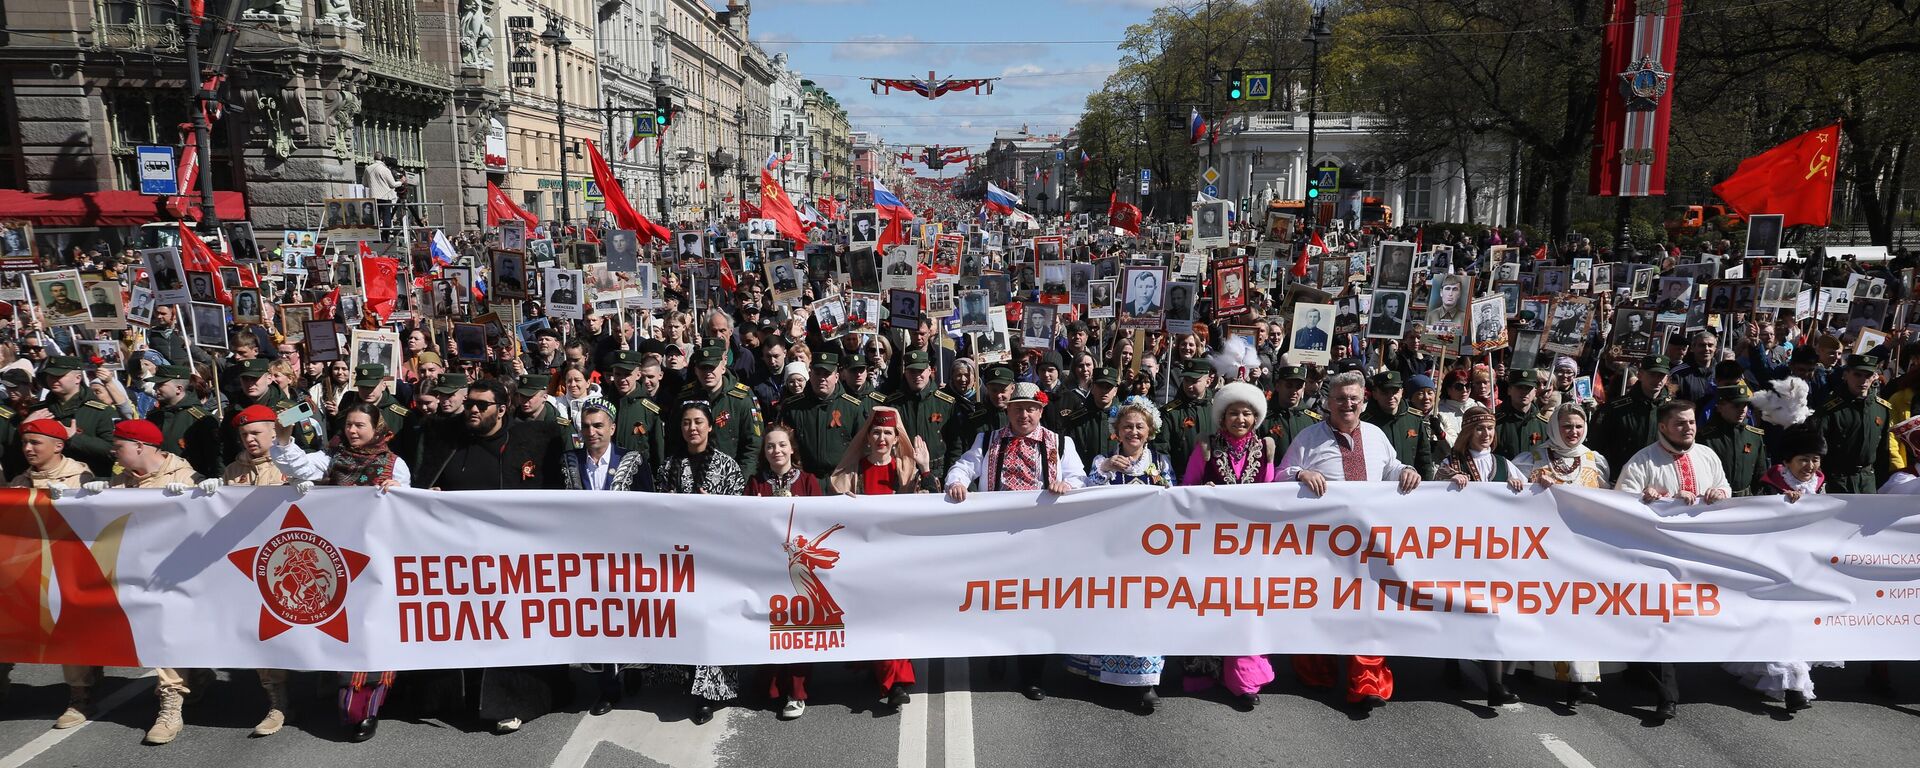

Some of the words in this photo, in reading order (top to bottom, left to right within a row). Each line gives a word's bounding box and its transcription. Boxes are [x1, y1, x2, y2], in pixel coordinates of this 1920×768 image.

[271, 532, 316, 548] ВЕЛИКОЙ
[1141, 523, 1200, 556] ОТ
[1213, 523, 1550, 566] БЛАГОДАРНЫХ
[260, 546, 273, 564] ЛЕТ
[318, 539, 345, 578] ПОБЕДЫ
[258, 565, 267, 577] 80
[394, 545, 695, 596] БЕССМЕРТНЫЙ
[769, 594, 810, 626] 80
[959, 576, 1318, 617] ЛЕНИНГРАДЦЕВ
[1332, 577, 1362, 610] И
[1377, 579, 1721, 623] ПЕТЕРБУРЖЦЕВ
[281, 610, 297, 621] 1941
[310, 610, 328, 621] 1945
[399, 600, 509, 643] ПОЛК
[521, 598, 677, 639] РОССИИ
[1825, 612, 1909, 626] ЛАТВИЙСКАЯ
[769, 631, 845, 652] ПОБЕДА!
